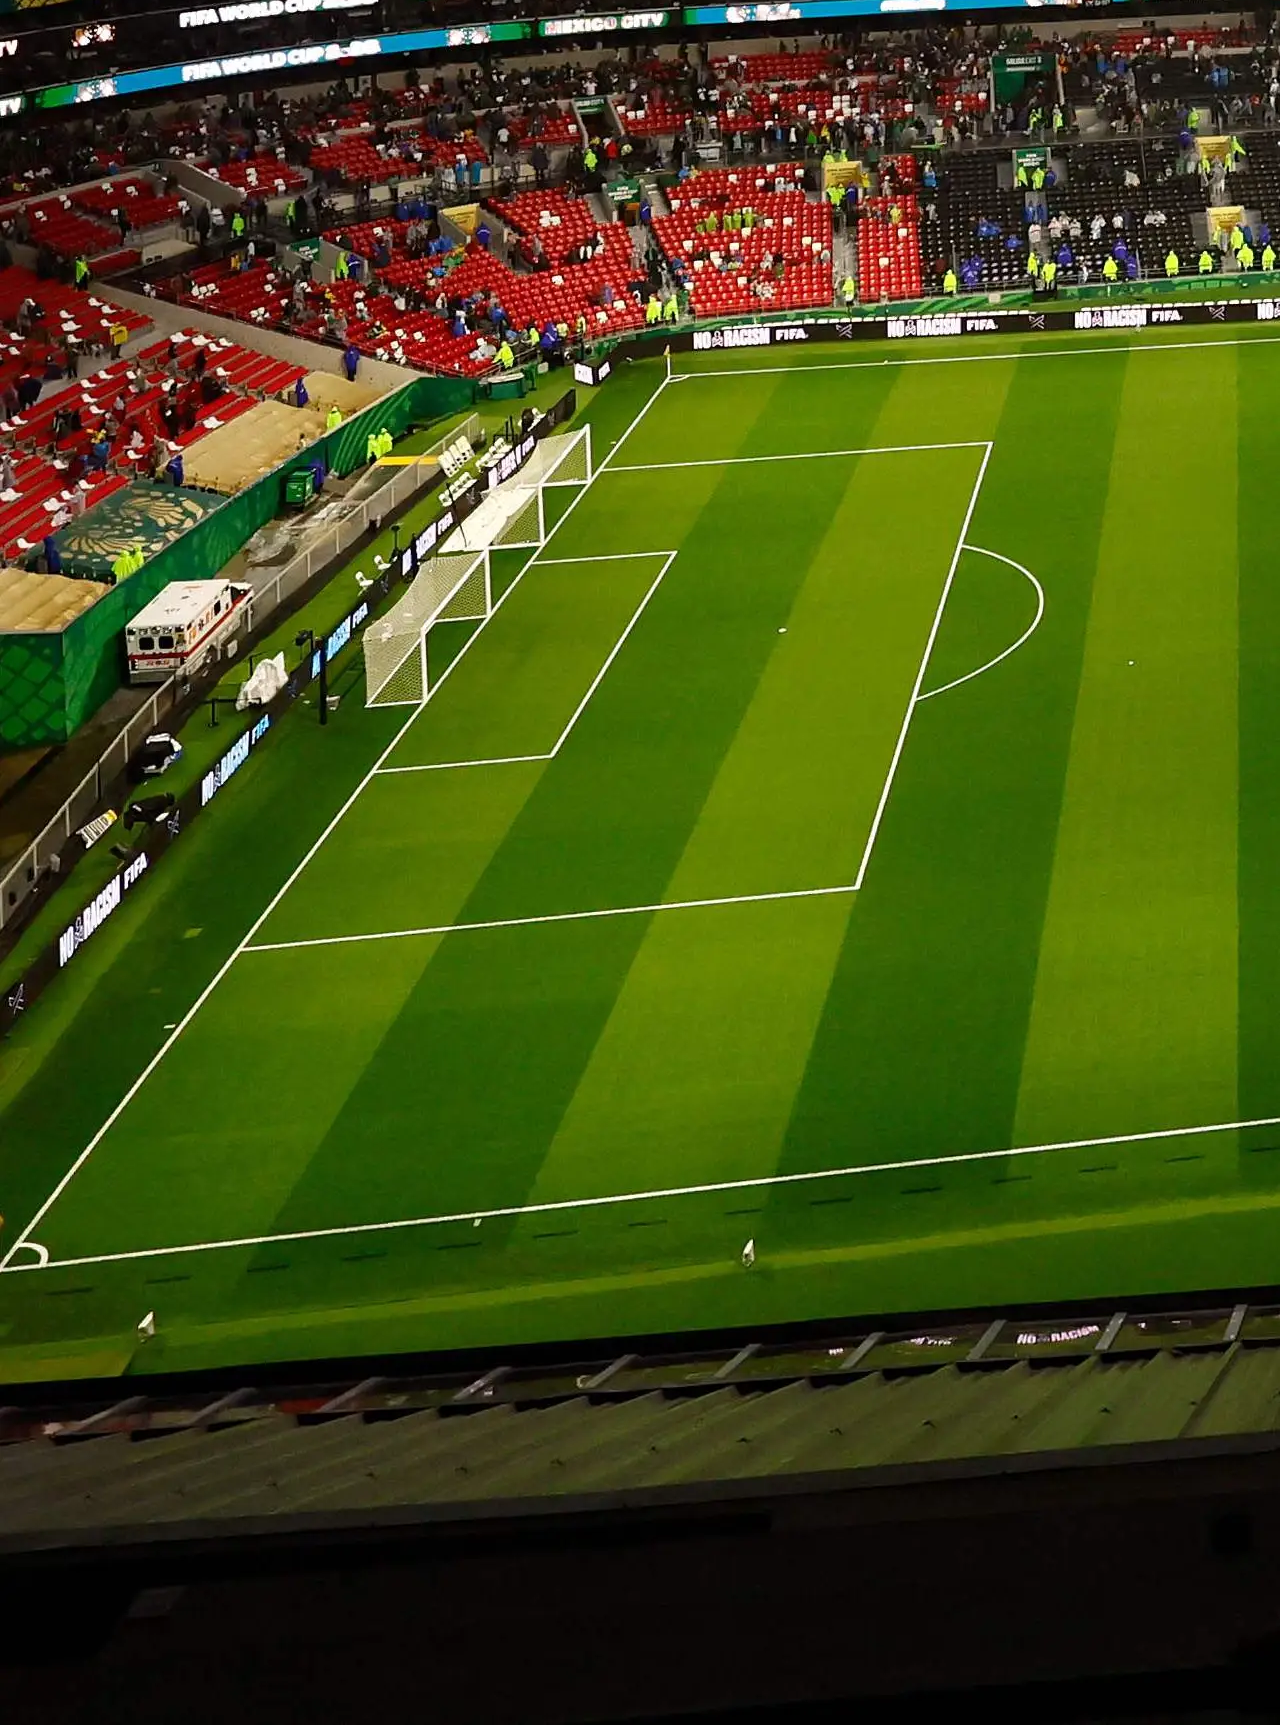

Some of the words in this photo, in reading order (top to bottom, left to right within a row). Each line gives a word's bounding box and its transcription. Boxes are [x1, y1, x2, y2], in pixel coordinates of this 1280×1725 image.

[180, 8, 219, 28] FIFA
[219, 1, 284, 22] WORLD
[545, 16, 617, 36] MEXICO
[620, 12, 665, 30] CITY
[182, 63, 222, 82] FIFA
[221, 56, 286, 77] WORLD
[1074, 311, 1092, 329] NO
[1103, 308, 1147, 328] RACISM
[1152, 309, 1183, 323] FIFA
[1257, 302, 1273, 320] NO
[693, 331, 711, 350] NO
[723, 328, 771, 347] RACISM
[775, 327, 809, 341] FIFA
[887, 319, 904, 338] NO
[917, 317, 962, 336] RACISM
[966, 318, 998, 332] FIFA
[59, 925, 75, 967] NO
[83, 874, 121, 940] RACISM
[123, 852, 149, 890] FIFA
